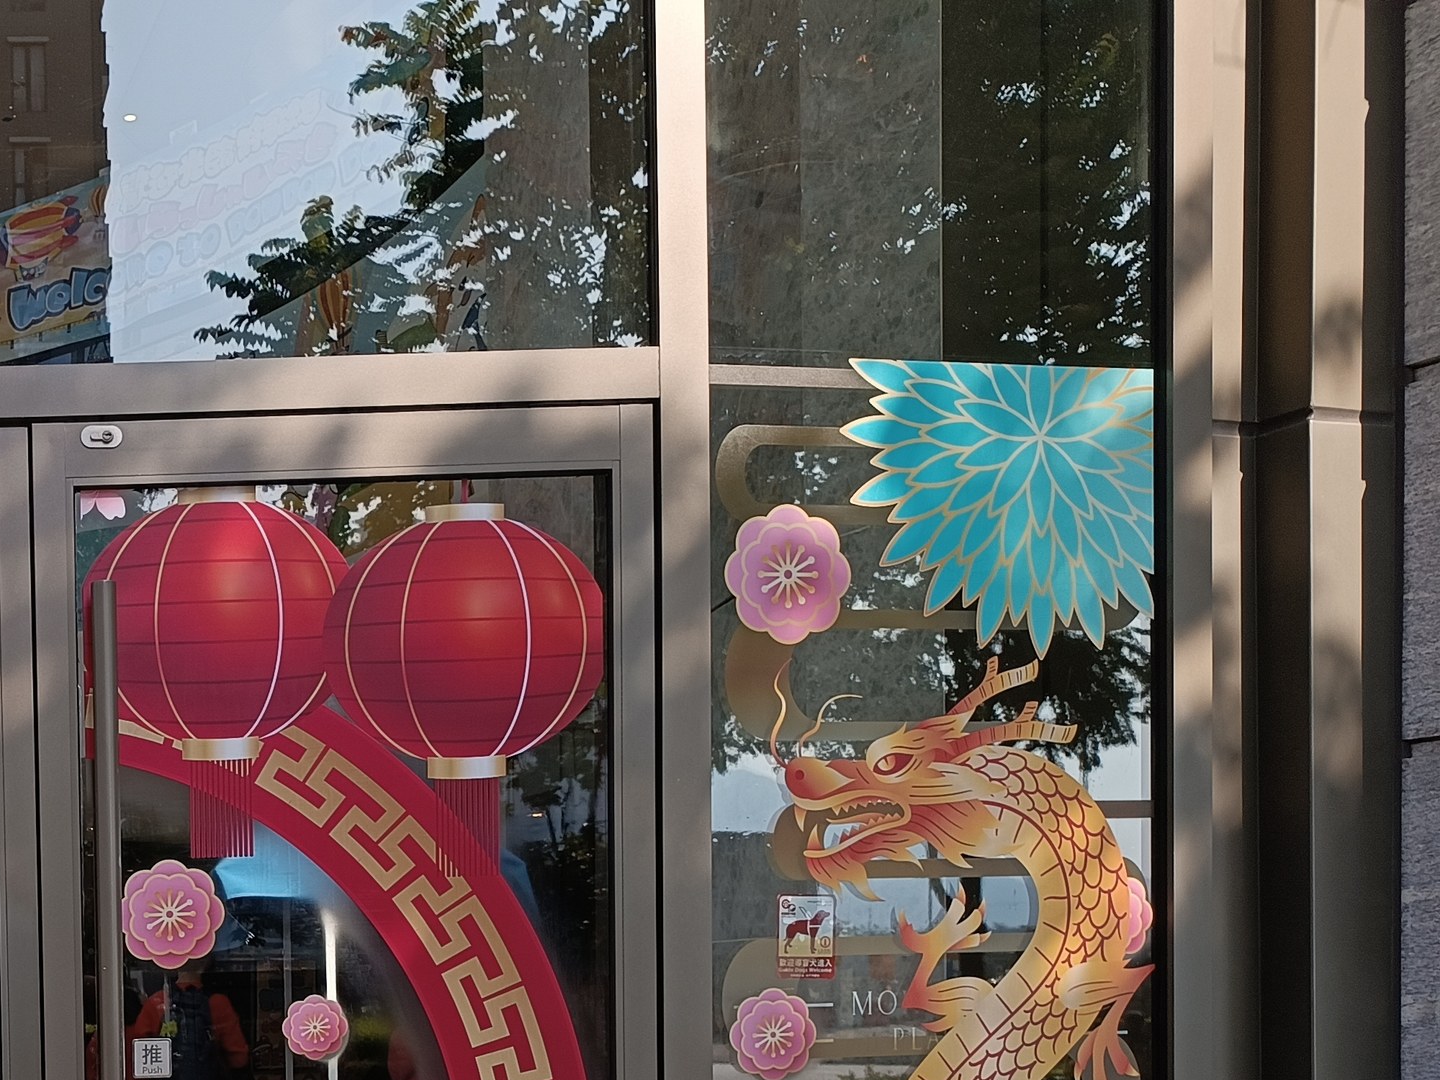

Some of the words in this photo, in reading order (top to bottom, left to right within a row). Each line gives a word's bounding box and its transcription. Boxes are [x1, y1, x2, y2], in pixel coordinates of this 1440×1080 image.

[893, 1027, 939, 1050] PLA
[142, 1044, 163, 1065] 推
[142, 1066, 163, 1074] Push
